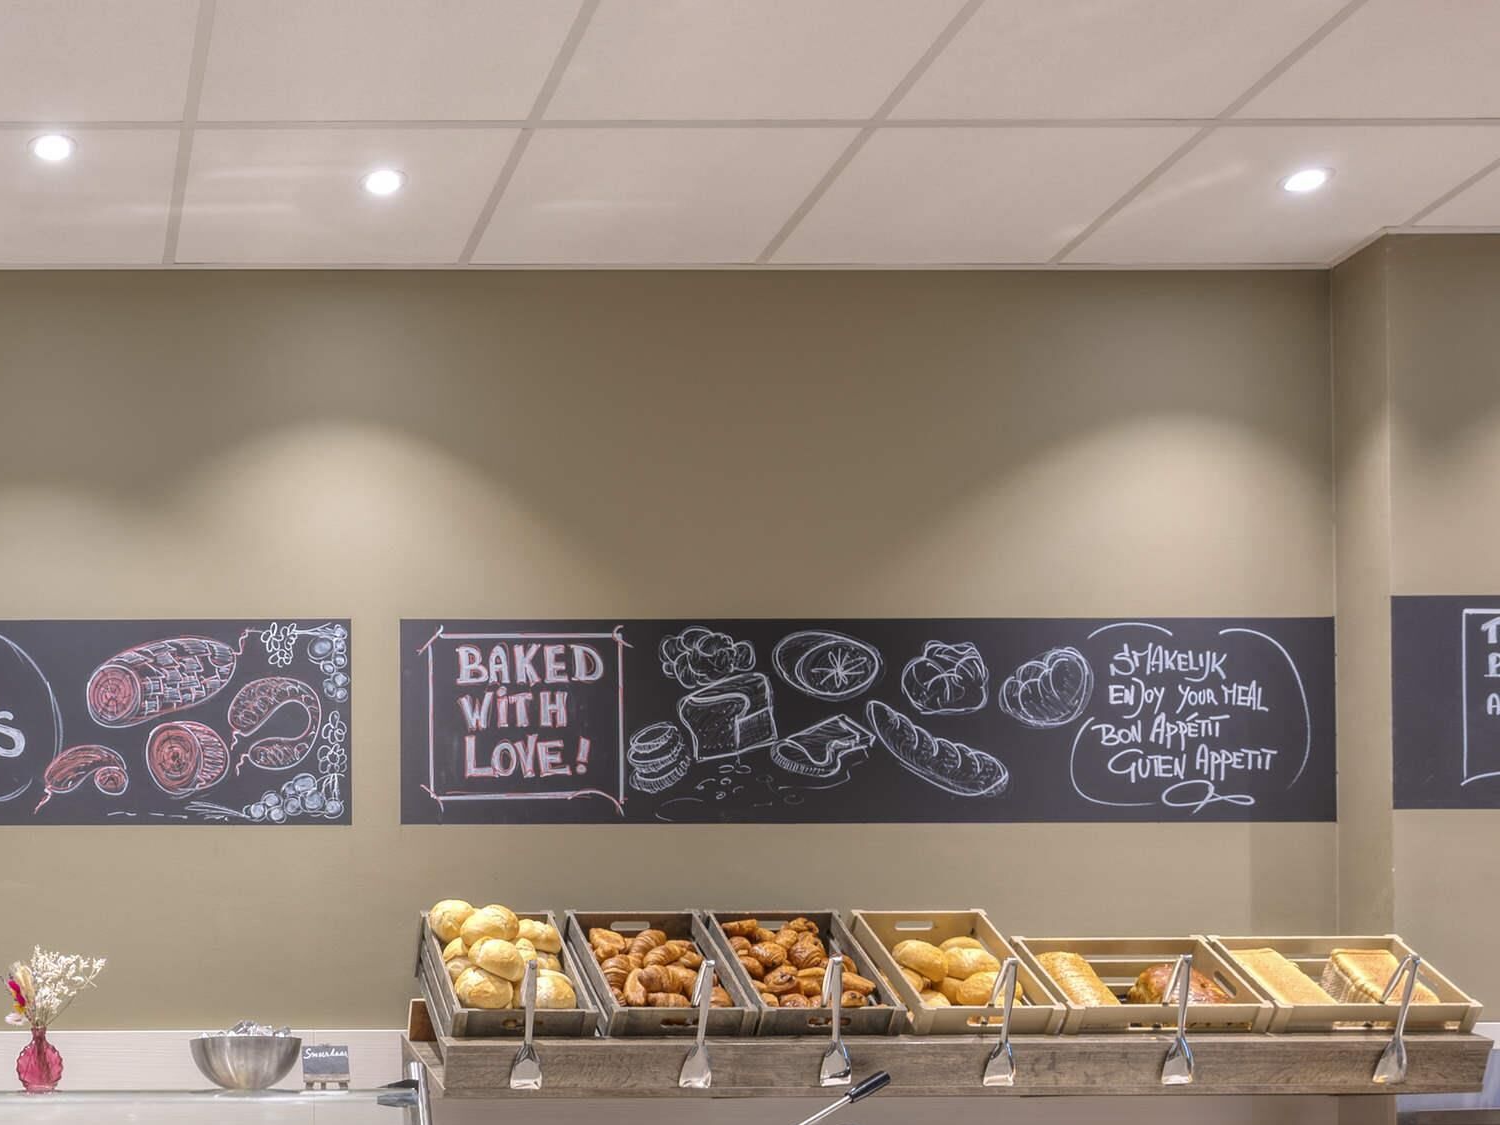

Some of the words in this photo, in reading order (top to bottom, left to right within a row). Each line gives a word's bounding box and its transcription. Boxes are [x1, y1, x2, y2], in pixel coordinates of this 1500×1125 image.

[456, 641, 605, 687] BAKED
[1109, 642, 1228, 682] SMAKELIJK
[1108, 677, 1165, 719] ENJOY
[1176, 684, 1219, 714] YOUR
[1220, 680, 1269, 712] MEAL
[1091, 719, 1142, 746] BON
[1107, 748, 1187, 783] GUTEN
[1195, 743, 1278, 781] APPETIT
